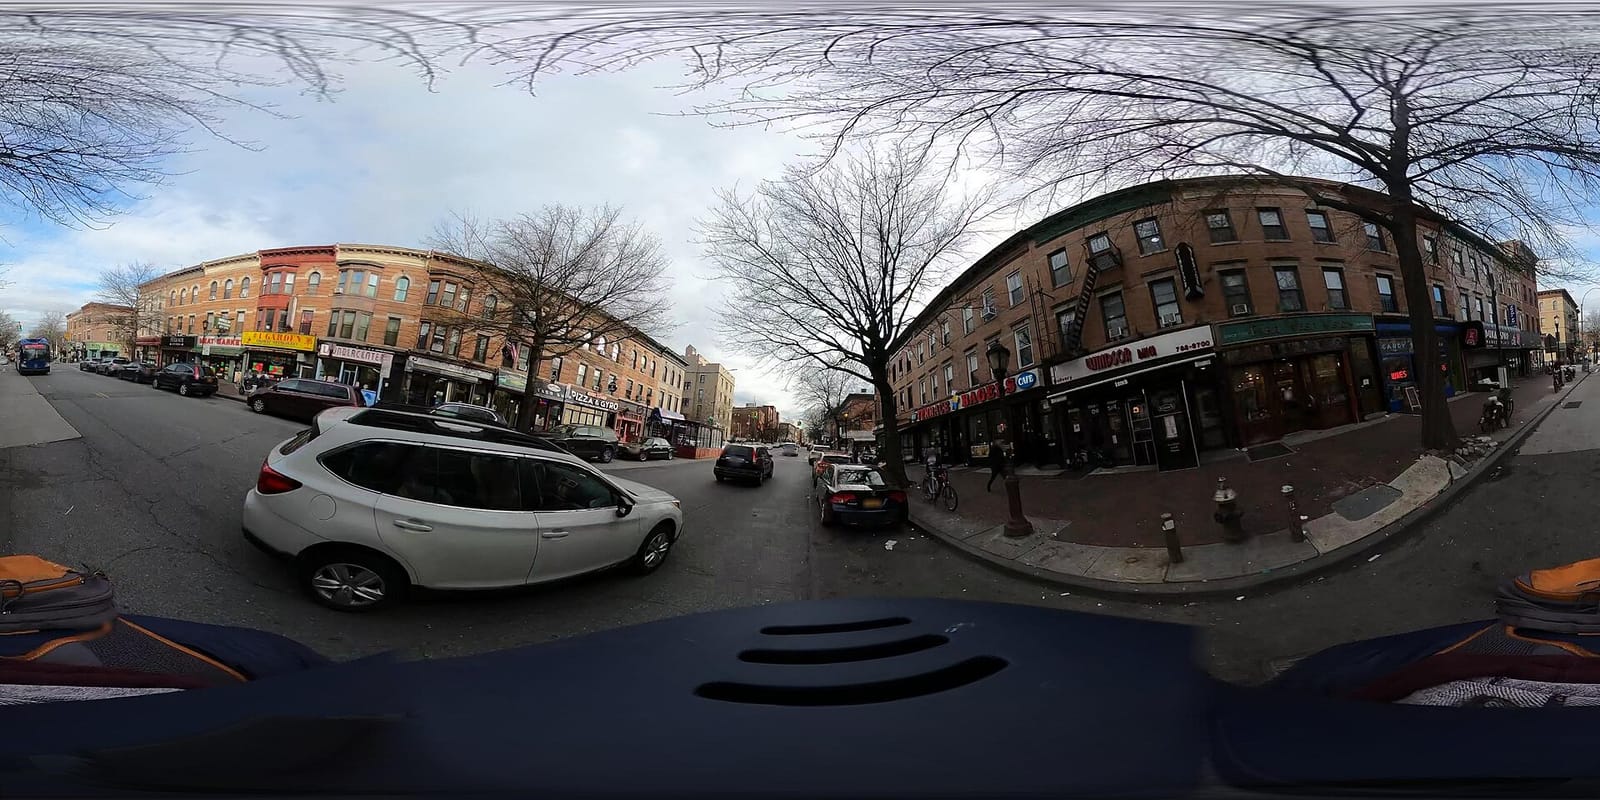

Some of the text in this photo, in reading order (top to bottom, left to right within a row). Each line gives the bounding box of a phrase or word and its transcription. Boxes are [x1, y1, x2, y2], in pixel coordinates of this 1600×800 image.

[216, 338, 241, 347] MARKE
[1018, 373, 1034, 386] CAFE
[571, 390, 593, 405] PIZZA
[600, 399, 619, 411] GYRO
